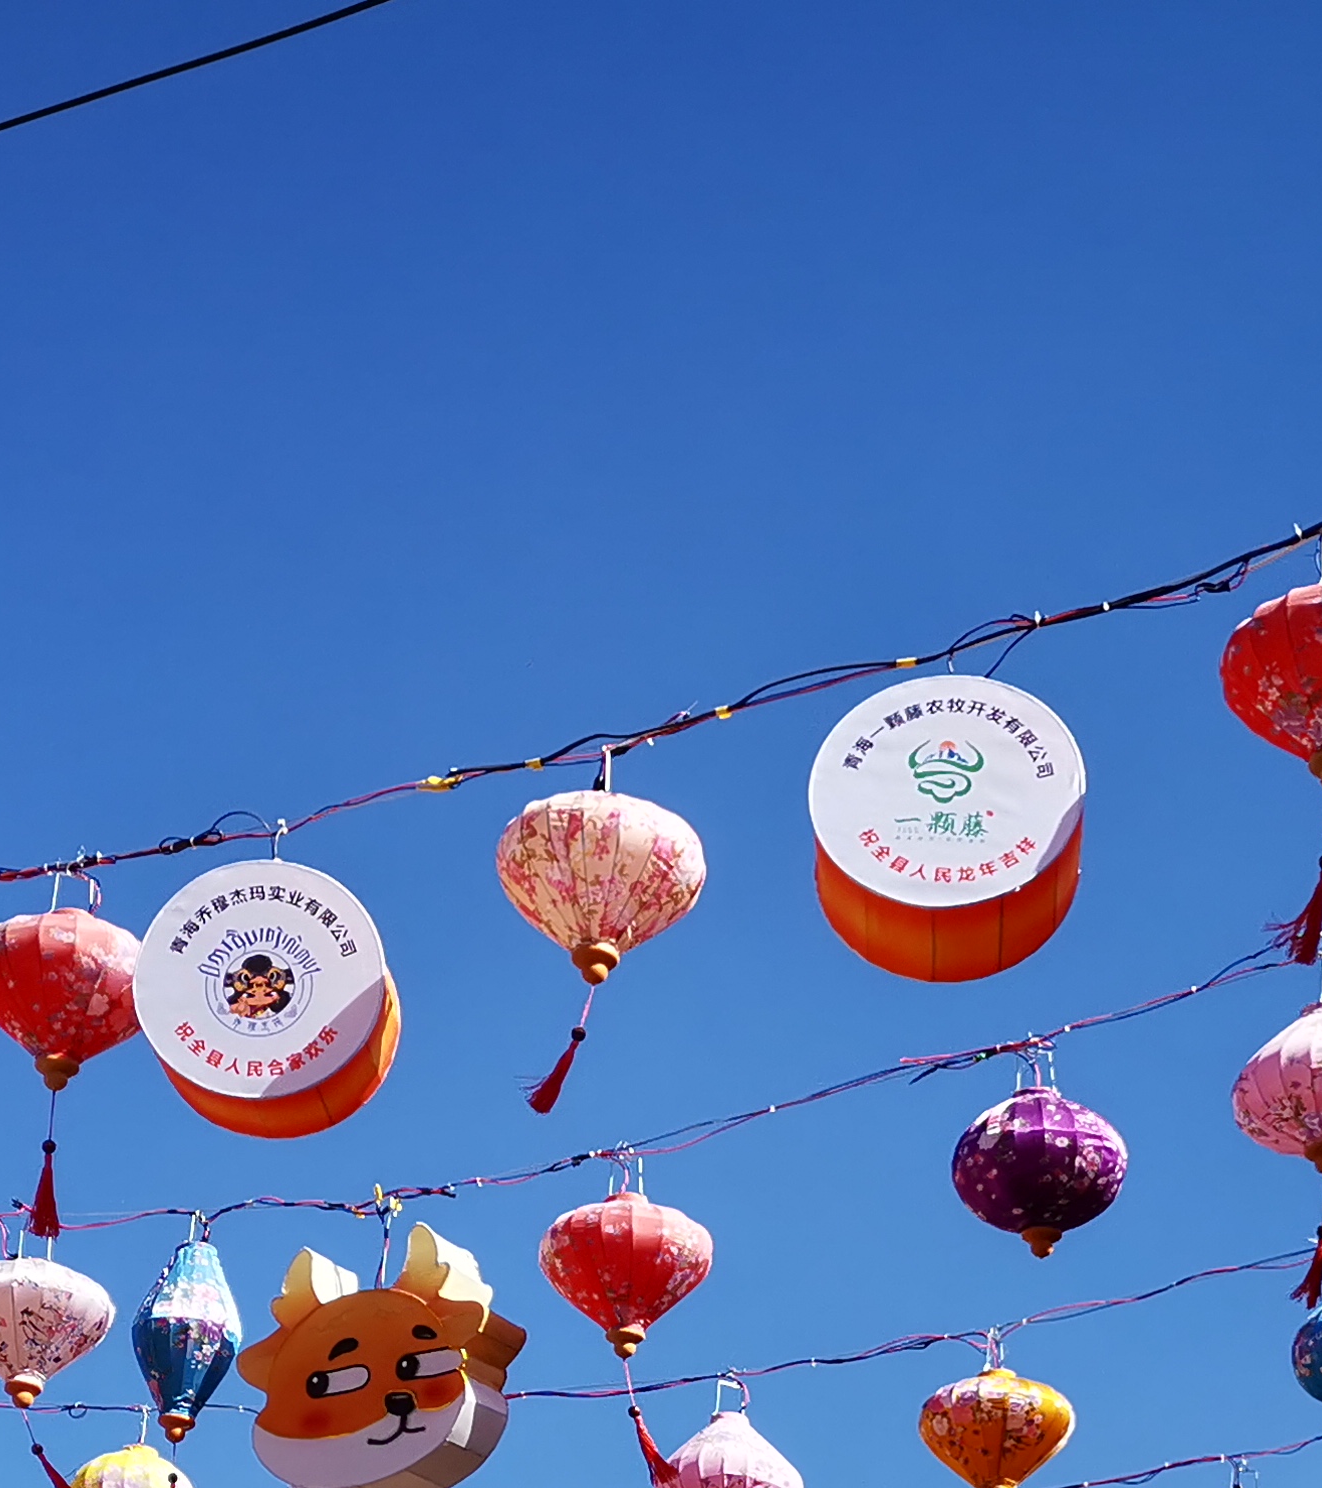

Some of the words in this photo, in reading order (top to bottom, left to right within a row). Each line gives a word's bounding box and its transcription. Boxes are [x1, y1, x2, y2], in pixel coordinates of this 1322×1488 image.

[894, 811, 989, 838] 一颗藤
[858, 828, 1038, 883] 祝全县人民龙年吉祥
[174, 1021, 339, 1078] 祝全县人民合家欢乐
